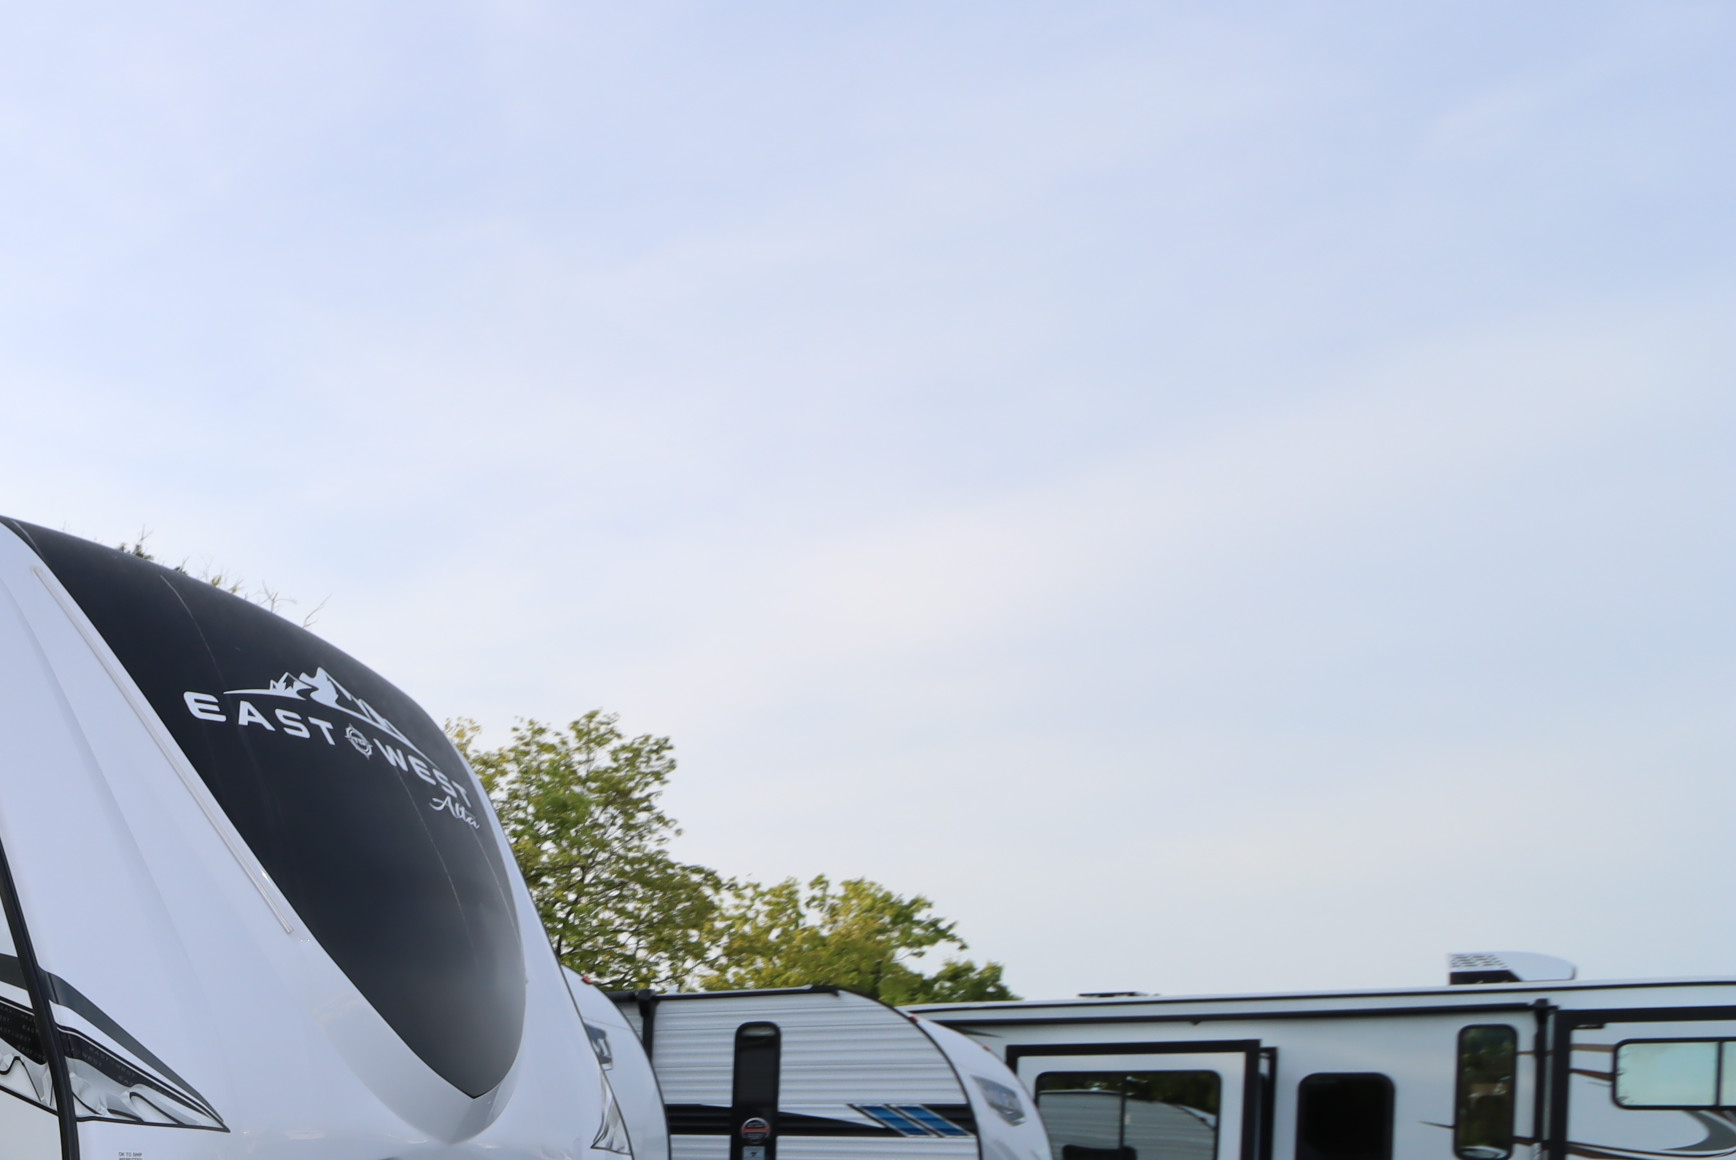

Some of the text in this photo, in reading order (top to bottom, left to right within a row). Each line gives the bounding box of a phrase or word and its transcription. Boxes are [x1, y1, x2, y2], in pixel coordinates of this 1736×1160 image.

[183, 691, 336, 746] EAST
[372, 738, 472, 808] WEST
[429, 795, 480, 829] Alta
